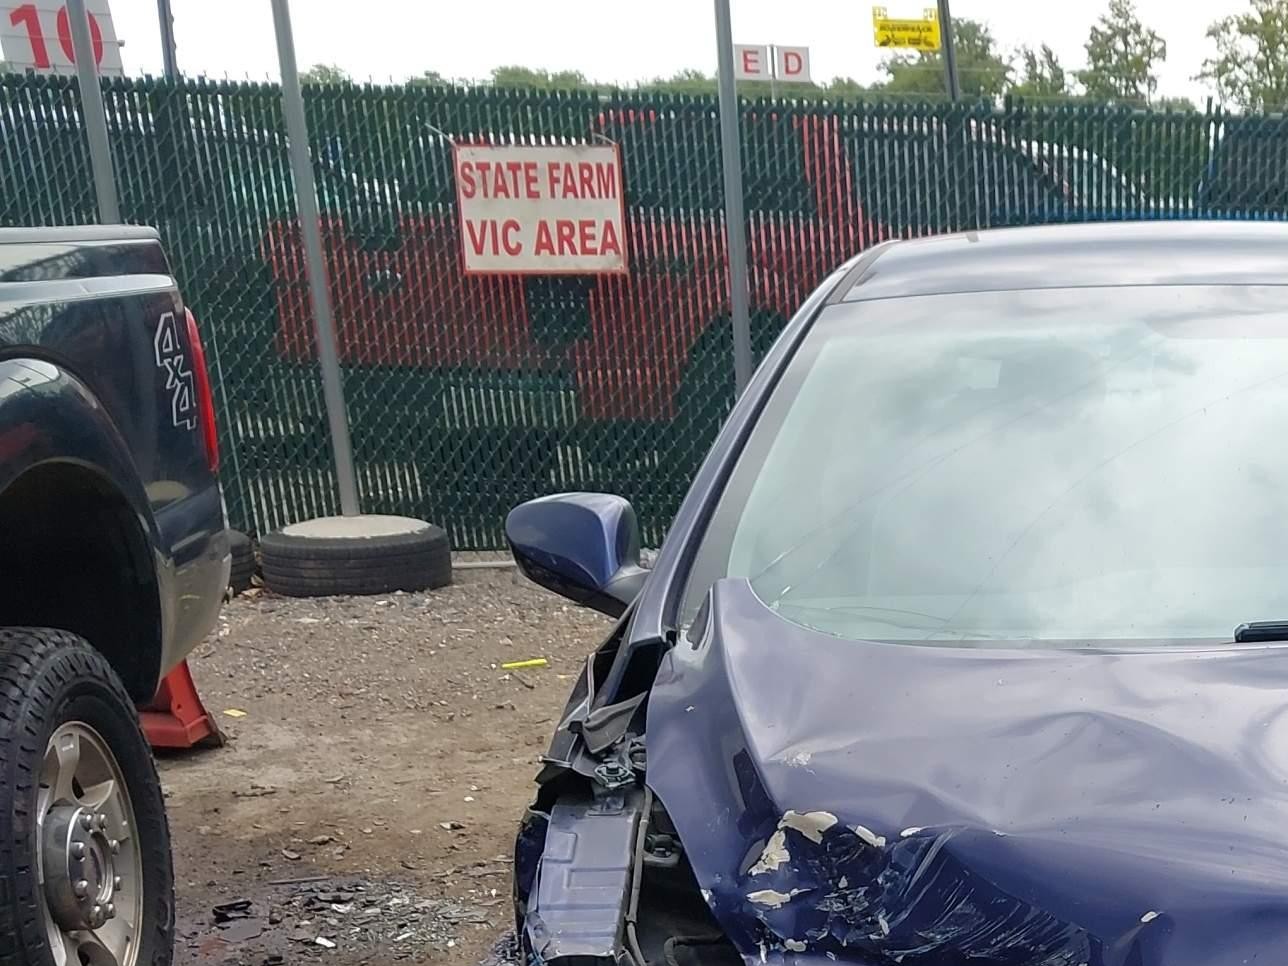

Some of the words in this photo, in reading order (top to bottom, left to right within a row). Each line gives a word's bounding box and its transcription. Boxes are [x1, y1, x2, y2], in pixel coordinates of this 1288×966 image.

[9, 4, 103, 72] 10
[743, 50, 760, 73] E
[784, 52, 802, 74] D
[460, 161, 540, 199] STATE
[547, 162, 616, 199] FARM
[466, 219, 522, 256] VIC
[534, 219, 621, 256] AREA
